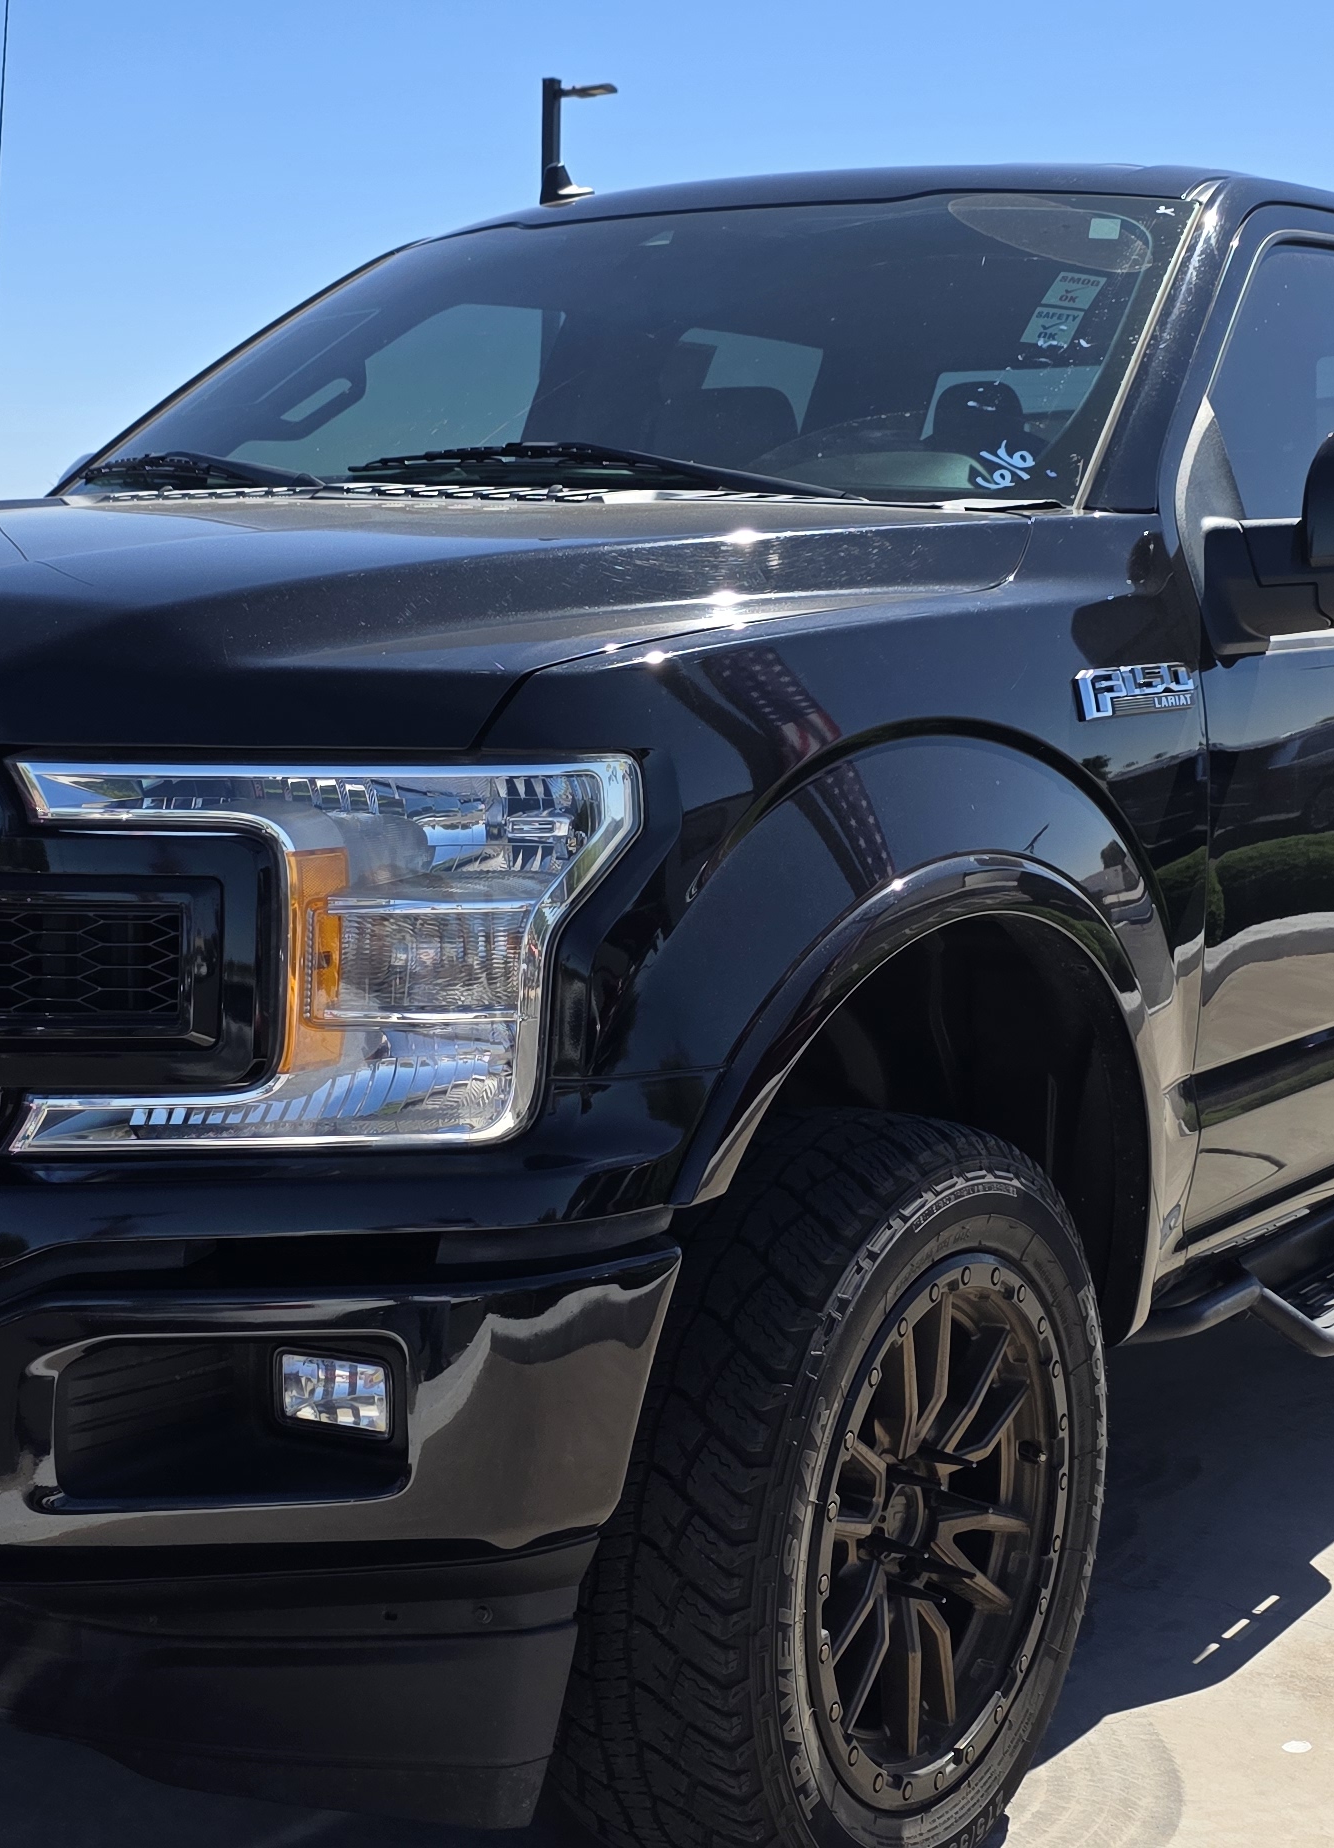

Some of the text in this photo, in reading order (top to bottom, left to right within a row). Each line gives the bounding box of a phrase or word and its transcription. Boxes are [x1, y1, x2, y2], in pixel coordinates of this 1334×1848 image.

[1058, 294, 1080, 304] OK
[1035, 310, 1080, 322] SAFETY
[1037, 331, 1058, 342] OK
[1154, 694, 1192, 708] LARIAT
[777, 1396, 828, 1821] TRAVELSTAR
[949, 1789, 1005, 1848] 275/5
